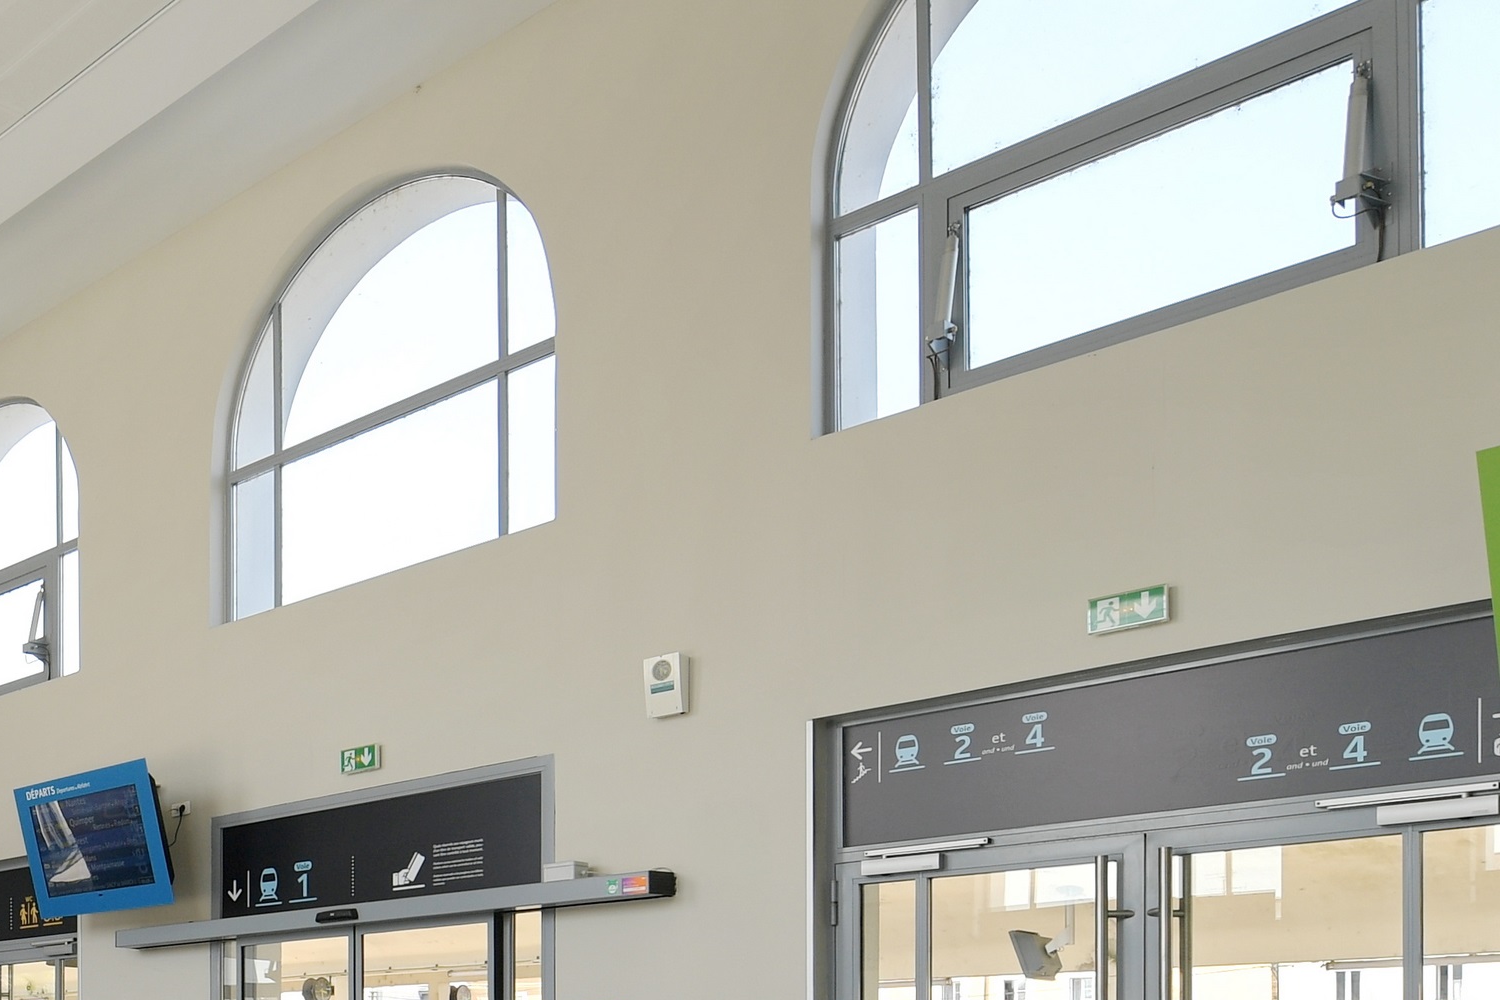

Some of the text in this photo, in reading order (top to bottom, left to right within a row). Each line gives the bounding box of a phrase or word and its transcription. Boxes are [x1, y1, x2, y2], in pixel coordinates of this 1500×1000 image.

[1025, 713, 1044, 722] Voie
[953, 725, 971, 733] Voie
[1343, 723, 1367, 733] Voie
[954, 724, 1045, 759] 2 et 4
[1250, 735, 1273, 745] Voie
[982, 744, 1015, 755] and und
[1251, 735, 1368, 775] 2 et 4
[1286, 758, 1329, 771] and und
[25, 785, 56, 801] DÉPARTS
[297, 873, 308, 897] 1
